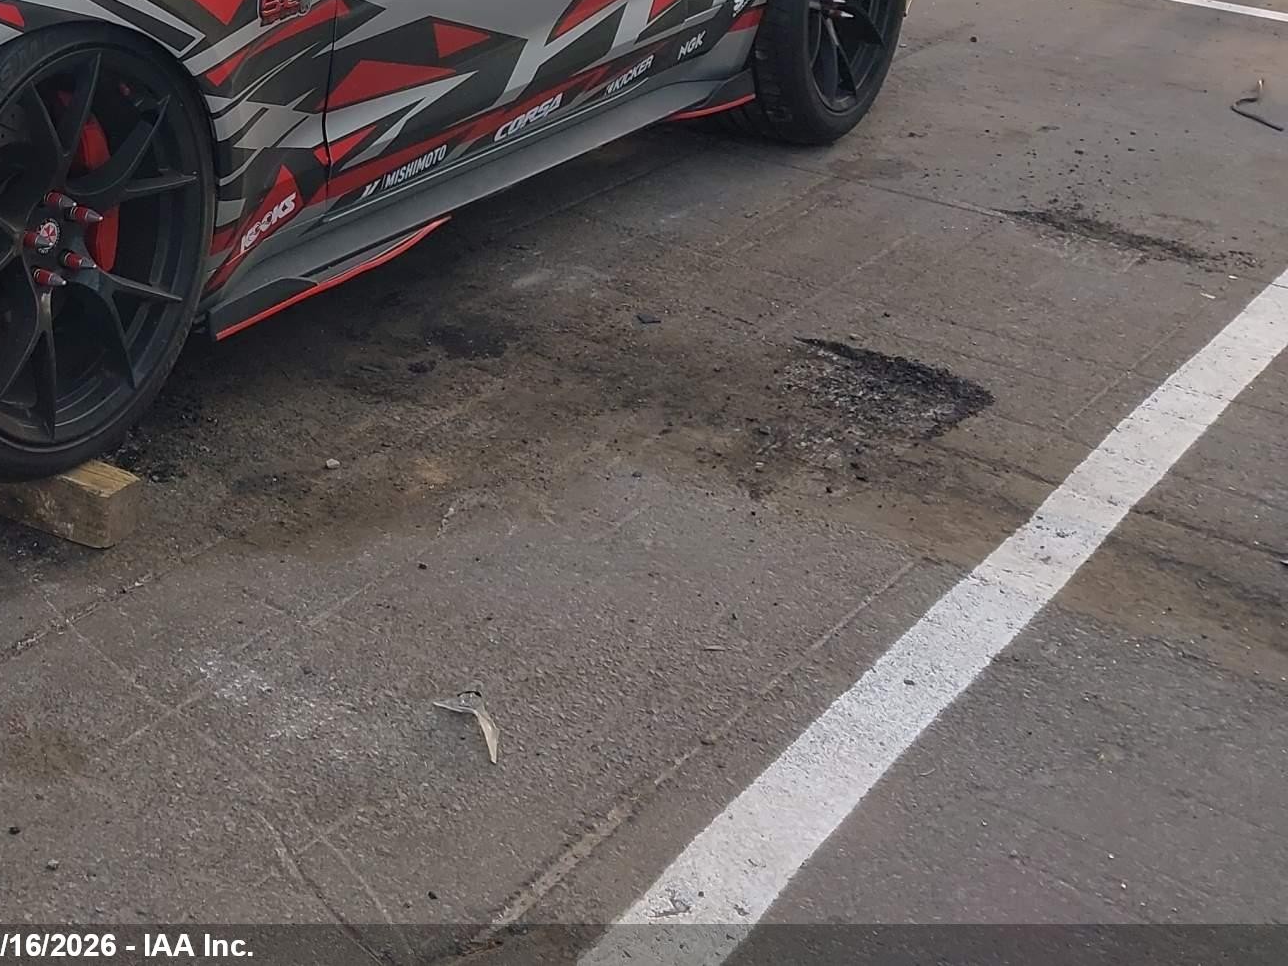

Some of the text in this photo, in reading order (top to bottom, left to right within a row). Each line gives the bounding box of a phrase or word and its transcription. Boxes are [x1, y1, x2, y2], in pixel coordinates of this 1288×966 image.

[677, 30, 707, 61] NGK
[613, 54, 655, 91] KICKER
[494, 91, 564, 143] CORSA
[385, 144, 448, 190] MISHIMOTO
